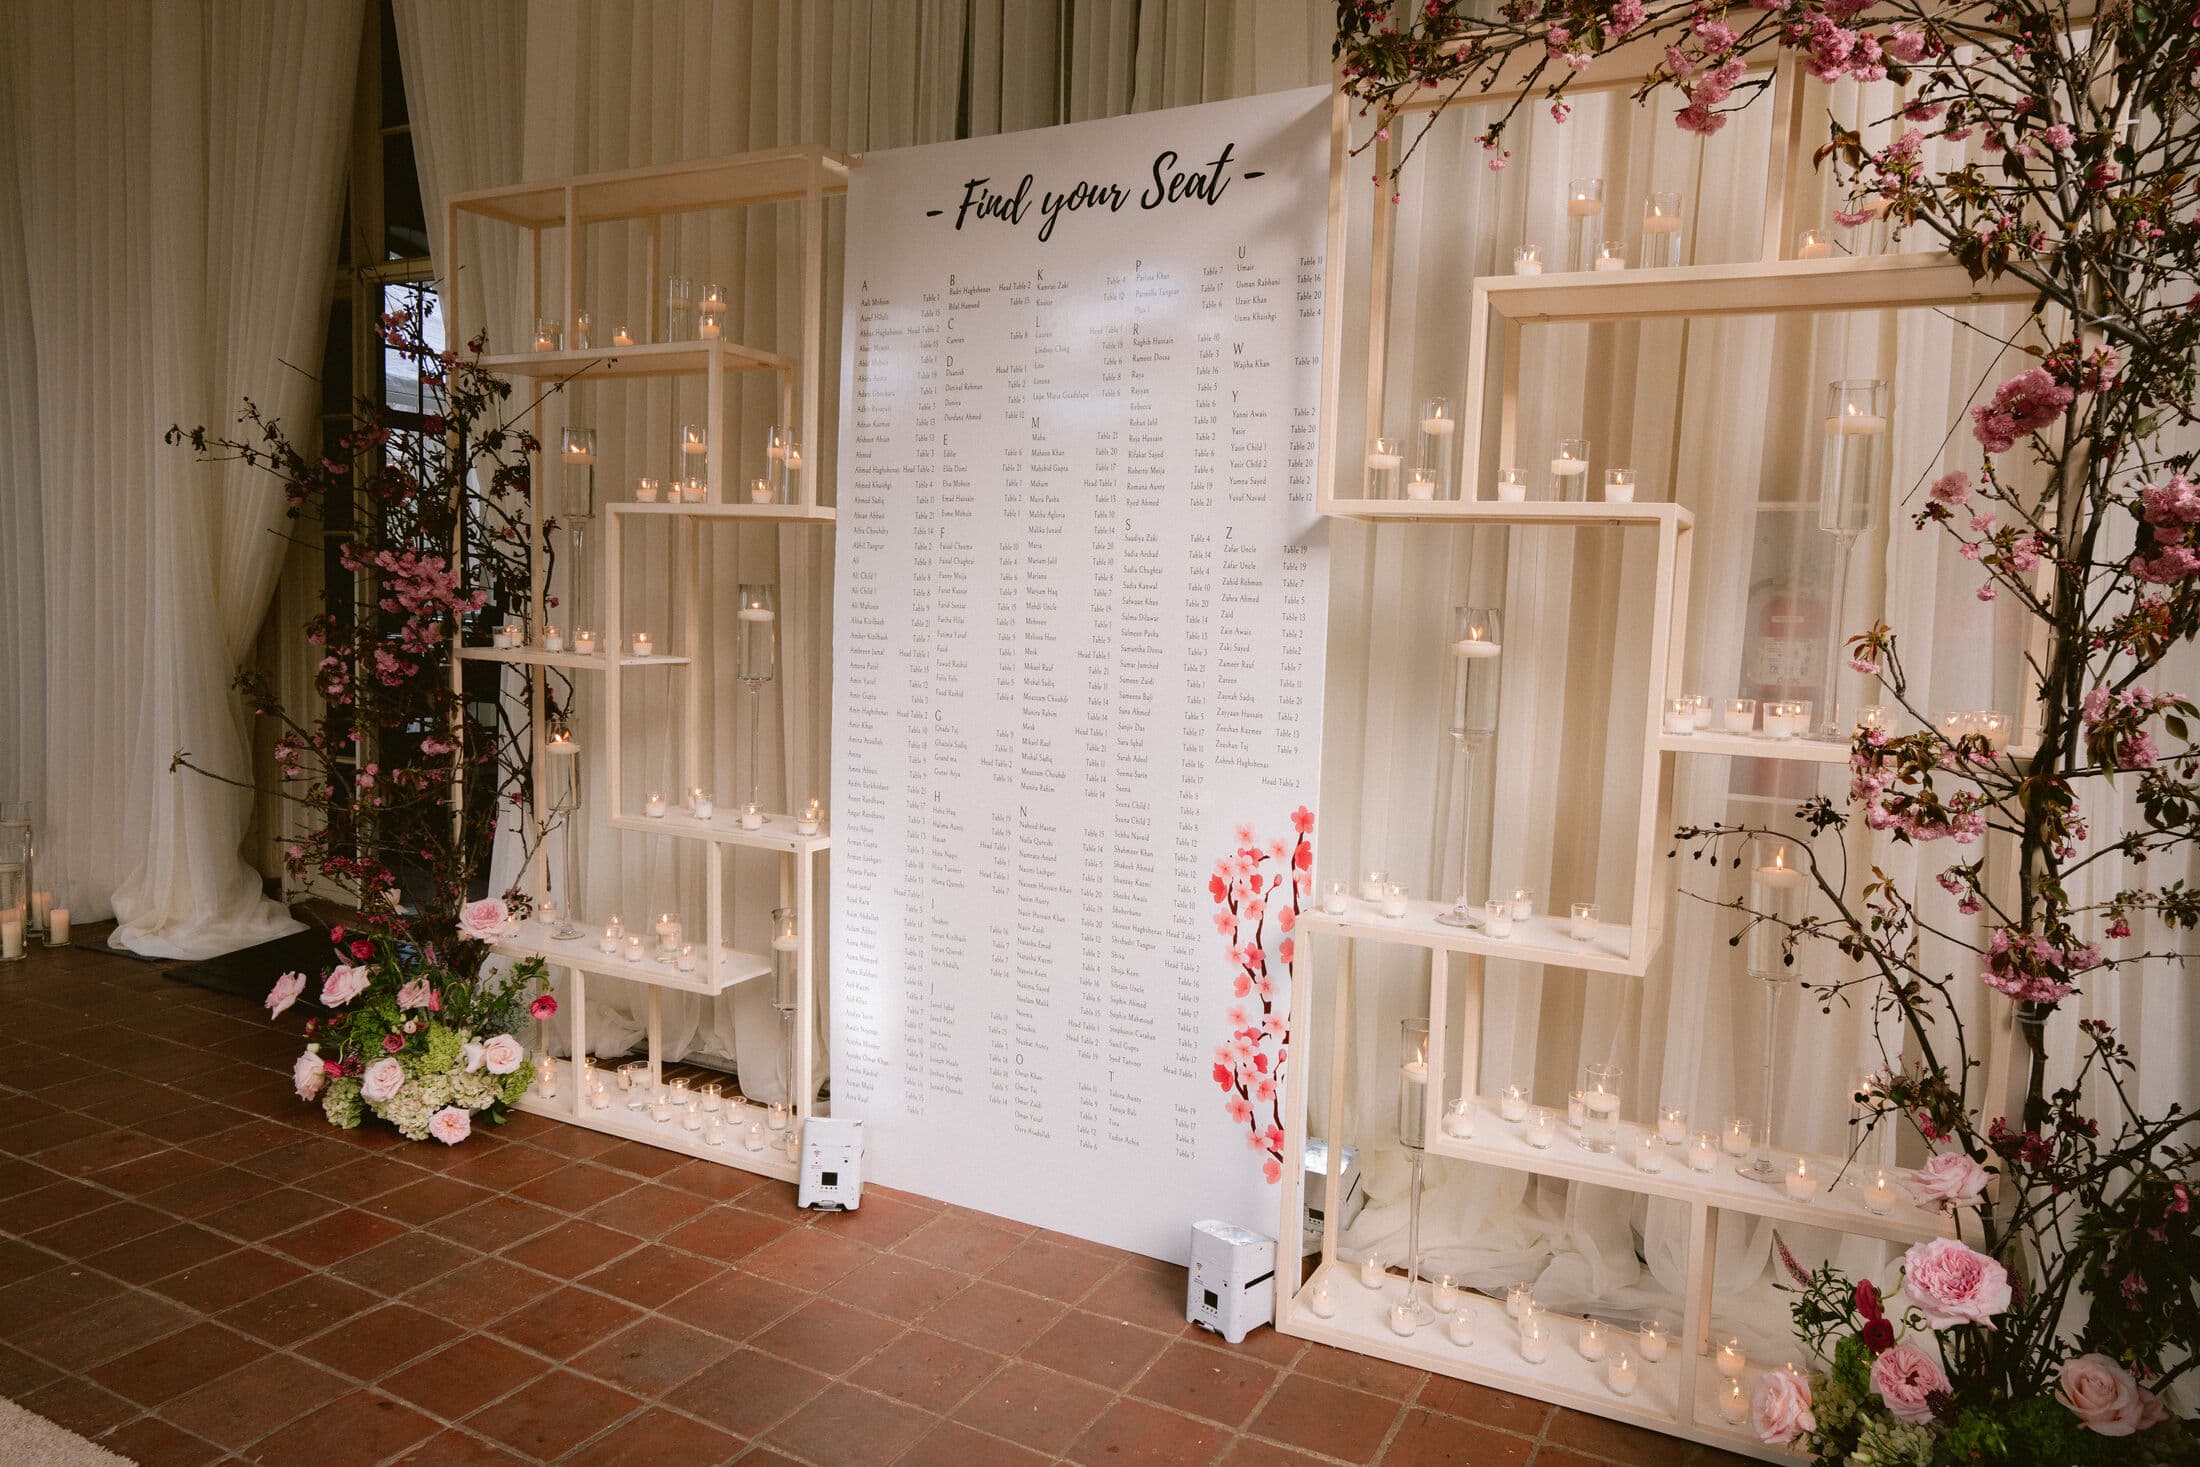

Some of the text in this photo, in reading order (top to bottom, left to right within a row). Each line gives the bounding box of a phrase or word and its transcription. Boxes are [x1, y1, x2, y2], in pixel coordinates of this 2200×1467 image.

[955, 174, 1033, 230] Find
[1038, 180, 1131, 243] your
[1141, 142, 1234, 210] Seat
[1238, 246, 1245, 259] U
[1136, 260, 1141, 272] P
[1300, 258, 1315, 266] Table
[1037, 269, 1043, 280] K
[1204, 267, 1218, 276] Table
[950, 274, 955, 286] B
[1298, 274, 1312, 283] Table
[862, 280, 868, 292] A
[999, 282, 1012, 291] Head
[1013, 282, 1026, 290] Table
[922, 293, 936, 302] Table
[1010, 298, 1023, 306] Table
[1253, 296, 1268, 304] Khan
[1297, 292, 1312, 300] Table
[1300, 308, 1315, 318] Table
[948, 318, 954, 329] C
[1036, 316, 1040, 328] L
[1133, 323, 1139, 335] R
[1233, 342, 1244, 354] W
[946, 356, 953, 367] D
[1255, 360, 1270, 368] Khan
[1296, 357, 1310, 366] Table
[1196, 367, 1210, 376] Table
[1232, 390, 1238, 402] Y
[1196, 400, 1210, 408] Table
[1031, 416, 1040, 428] M
[1194, 416, 1208, 424] Table
[1291, 425, 1306, 434] Table
[943, 434, 948, 446] E
[1097, 432, 1110, 440] Table
[902, 464, 916, 473] Head
[918, 464, 930, 472] Table
[1096, 464, 1108, 472] Table
[1246, 460, 1262, 468] Child
[1288, 459, 1303, 468] Table
[1125, 518, 1131, 530] S
[940, 527, 945, 538] F
[1226, 526, 1232, 539] Z
[1284, 545, 1298, 554] Table
[1190, 566, 1204, 575] Table
[1094, 588, 1106, 597] Table
[1090, 604, 1104, 612] Table
[1282, 612, 1298, 621] Table
[1282, 629, 1298, 638] Table
[1281, 662, 1297, 672] Table
[935, 710, 941, 722] G
[1185, 712, 1199, 720] Table
[1278, 712, 1294, 722] Table
[1183, 728, 1198, 736] Table
[1278, 745, 1292, 754] Table
[1262, 777, 1276, 786] Head
[1280, 778, 1294, 788] Table
[934, 791, 940, 802] H
[1020, 806, 1027, 818] N
[1016, 1054, 1024, 1066] O
[1176, 1053, 1190, 1062] Table
[1108, 1070, 1114, 1082] T
[1163, 1064, 1177, 1075] Head
[1179, 1068, 1192, 1078] Table
[1080, 1096, 1094, 1106] Table
[1176, 1134, 1190, 1143] Table
